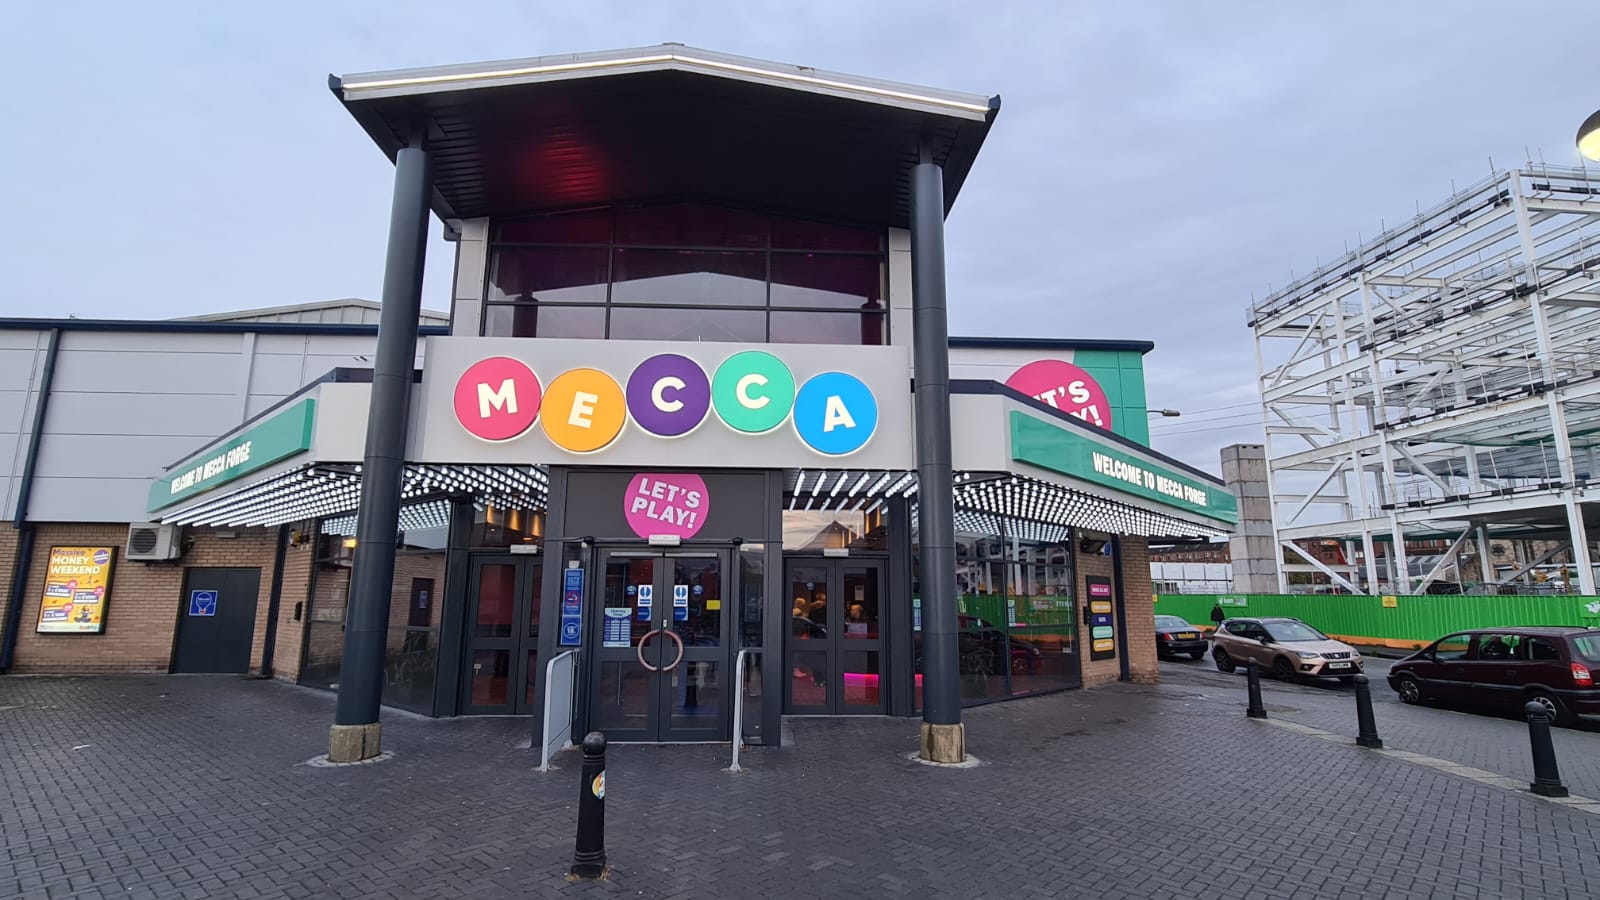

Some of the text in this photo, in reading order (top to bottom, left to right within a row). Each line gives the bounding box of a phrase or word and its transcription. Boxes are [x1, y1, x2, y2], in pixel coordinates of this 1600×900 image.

[477, 373, 857, 433] MECCA
[1033, 381, 1090, 408] T'S
[171, 441, 252, 494] WELCOME TO MECCA FORGE
[1093, 452, 1207, 507] WELCOME TO MECCA FORGE
[639, 477, 701, 508] LET'S
[631, 496, 697, 529] PLAY!
[50, 566, 100, 574] WEEKEND
[52, 556, 89, 565] MONEY
